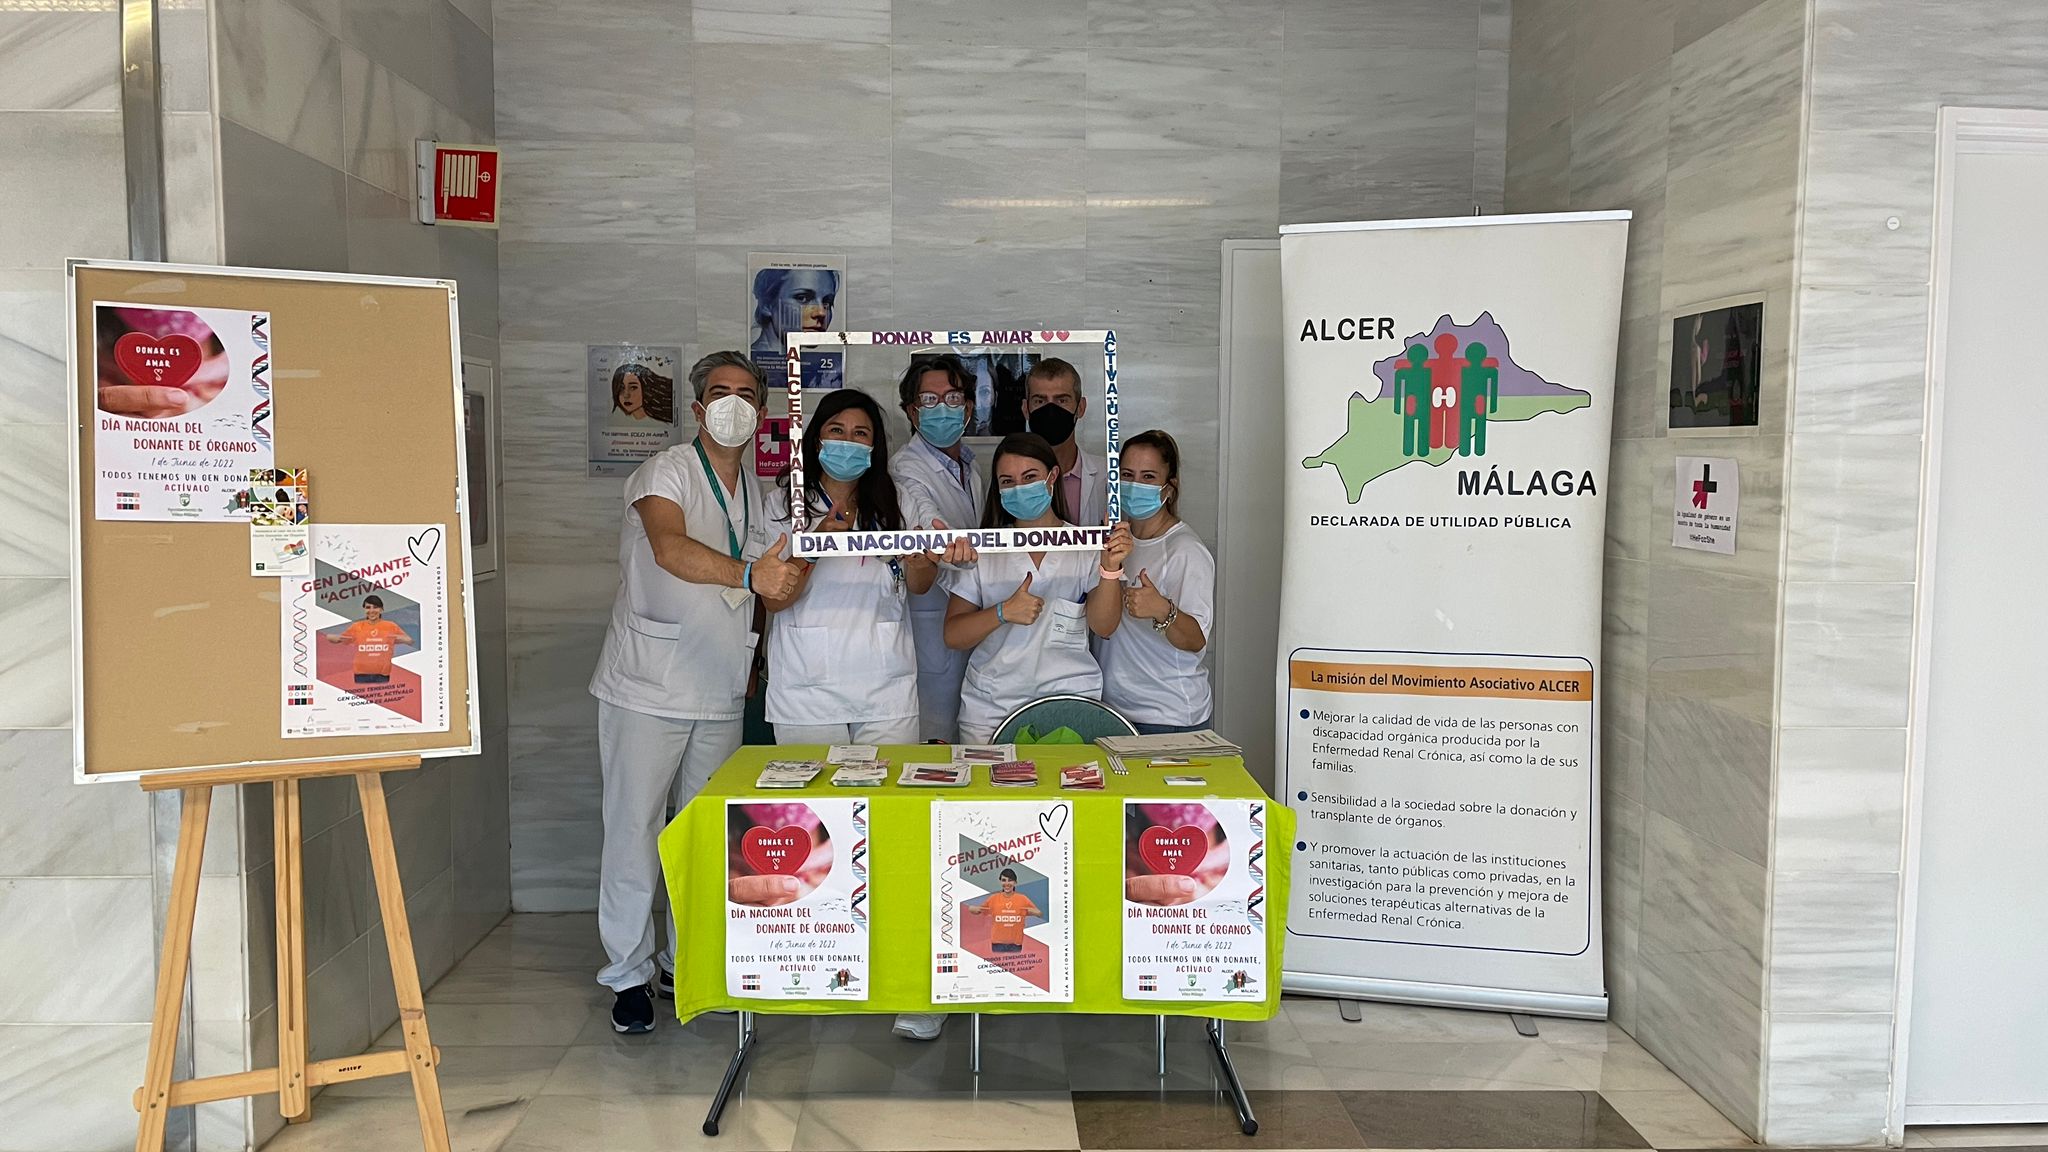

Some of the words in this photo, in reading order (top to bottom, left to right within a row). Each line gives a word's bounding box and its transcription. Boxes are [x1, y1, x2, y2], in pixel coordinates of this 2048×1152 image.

[872, 332, 933, 344] DONAR
[948, 332, 971, 345] ES
[981, 331, 1033, 344] AMAR
[1300, 318, 1394, 341] ALCER
[136, 346, 165, 355] DONAR
[170, 347, 180, 356] ES
[146, 360, 171, 368] AMAR
[820, 359, 833, 368] 25
[1104, 330, 1118, 395] ACTIVA
[786, 347, 802, 429] ALCER
[102, 418, 120, 431] DÍA
[126, 421, 180, 433] NACIONAL
[185, 422, 203, 434] DEL
[1107, 418, 1119, 453] GEN
[134, 439, 183, 451] DONANTE
[189, 440, 200, 451] DE
[207, 439, 257, 452] ÓRGANOS
[102, 471, 132, 479] TODOS
[138, 472, 179, 480] TENEMOS
[224, 474, 248, 482] DONA
[1458, 465, 1596, 496] MÁLAGA
[164, 482, 210, 492] ACTÍVALO
[1107, 457, 1119, 526] DONANT
[1311, 516, 1400, 526] DECLARADA
[1406, 517, 1424, 526] DE
[1431, 517, 1498, 527] UTILIDAD
[1505, 515, 1571, 528] PÚBLICA
[800, 535, 838, 552] DIA
[967, 532, 1008, 548] DEL
[301, 577, 334, 594] GEN
[337, 556, 412, 585] DONANTE
[1312, 671, 1323, 682] La
[1327, 672, 1365, 684] misión
[1370, 673, 1387, 685] del
[1392, 674, 1466, 688] Movimiento
[1470, 677, 1534, 690] Asociativo
[1539, 680, 1579, 692] ALCER
[1314, 710, 1355, 724] Mejorar
[1359, 713, 1368, 724] la
[1372, 714, 1412, 725] calidad
[1417, 716, 1430, 726] de
[1434, 717, 1457, 727] vida
[1462, 718, 1476, 728] de
[1481, 718, 1495, 728] las
[1500, 722, 1552, 731] personas
[1557, 724, 1578, 732] con
[1313, 726, 1383, 741] discapacidad
[1388, 733, 1437, 744] orgánica
[1442, 734, 1500, 746] producida
[1506, 739, 1525, 748] por
[1530, 737, 1539, 748] la
[1313, 743, 1378, 757] Enfermedad
[1384, 748, 1413, 758] Renal
[1418, 750, 1465, 763] Crónica,
[1470, 752, 1485, 762] así
[1489, 755, 1522, 764] como
[1527, 754, 1536, 765] la
[1541, 755, 1555, 766] de
[1560, 759, 1578, 767] sus
[1312, 758, 1356, 772] familias.
[1312, 792, 1376, 807] Sensibilidad
[1392, 798, 1400, 808] la
[1405, 801, 1455, 811] sociedad
[1460, 802, 1492, 813] sobre
[1497, 803, 1505, 814] la
[1510, 804, 1566, 817] donación
[1571, 811, 1577, 821] y
[1311, 810, 1373, 824] transplante
[1378, 814, 1391, 824] de
[1395, 815, 1445, 828] órganos.
[948, 852, 975, 865] GEN
[978, 832, 1042, 858] DONANTE
[1310, 842, 1318, 851] Y
[1322, 845, 1376, 856] promover
[1380, 847, 1389, 857] la
[1394, 850, 1449, 861] actuación
[1454, 852, 1467, 862] de
[1472, 852, 1487, 863] las
[1492, 856, 1566, 869] instituciones
[1310, 861, 1364, 874] sanitarias,
[1369, 865, 1398, 875] tanto
[1403, 866, 1449, 878] públicas
[1453, 871, 1485, 880] como
[1490, 873, 1541, 885] privadas,
[1547, 877, 1560, 885] en
[1566, 876, 1575, 886] la
[1310, 877, 1381, 890] investigación
[1387, 884, 1411, 892] para
[1416, 883, 1424, 893] la
[1430, 886, 1493, 897] prevención
[1498, 891, 1503, 900] y
[1508, 891, 1548, 902] mejora
[1554, 892, 1568, 903] de
[731, 908, 745, 919] DÍA
[750, 909, 793, 918] NACIONAL
[797, 908, 811, 917] DEL
[1128, 908, 1142, 918] DÍA
[1146, 909, 1189, 918] NACIONAL
[1193, 909, 1207, 919] DEL
[1309, 892, 1367, 906] soluciones
[1371, 898, 1441, 911] terapéuticas
[1445, 902, 1512, 915] alternativas
[1516, 906, 1530, 917] de
[1536, 907, 1544, 918] la
[757, 924, 795, 933] DONANTE
[800, 924, 810, 933] DE
[814, 921, 855, 933] ÓRGANOS
[1309, 908, 1376, 923] Enfermedad
[1382, 914, 1412, 925] Renal
[1417, 916, 1464, 928] Crónica.
[1152, 924, 1191, 934] DONANTE
[1196, 925, 1206, 934] DE
[1210, 923, 1251, 935] ÓRGANOS
[731, 955, 755, 963] TODOS
[828, 955, 864, 963] DONANTE,
[779, 963, 816, 972] ACTÍVALO
[1176, 964, 1213, 973] ACTÍVALO
[1224, 956, 1261, 964] DONANTE,
